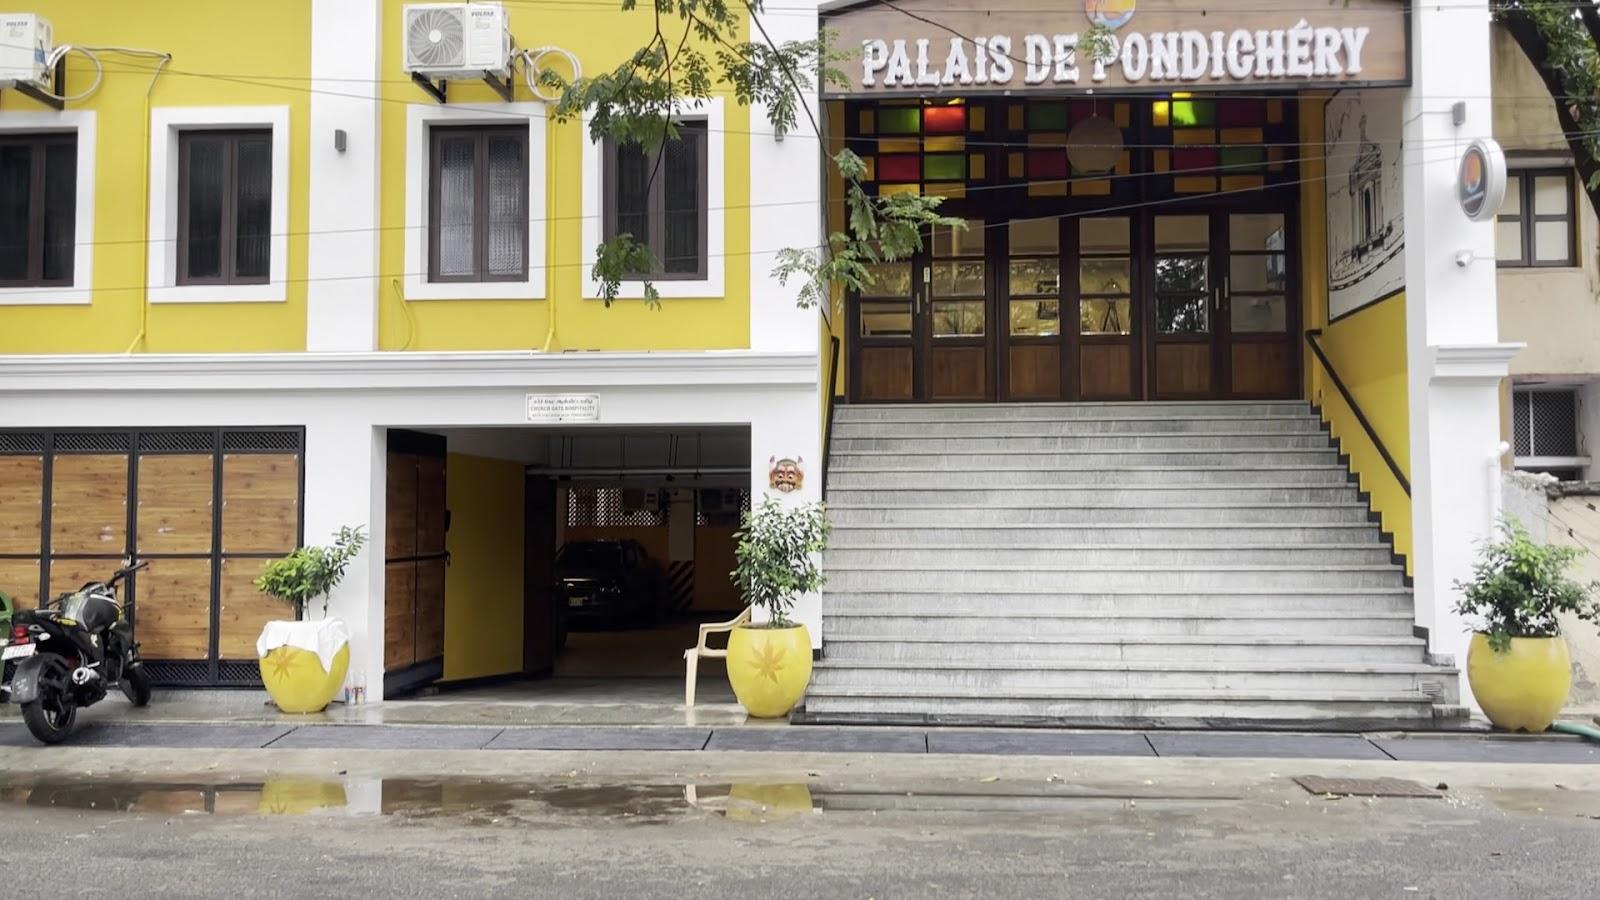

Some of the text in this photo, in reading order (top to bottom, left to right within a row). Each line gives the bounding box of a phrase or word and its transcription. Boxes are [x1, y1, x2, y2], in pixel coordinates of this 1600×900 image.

[862, 18, 1370, 87] PALAIS DE PONDICHÉRY
